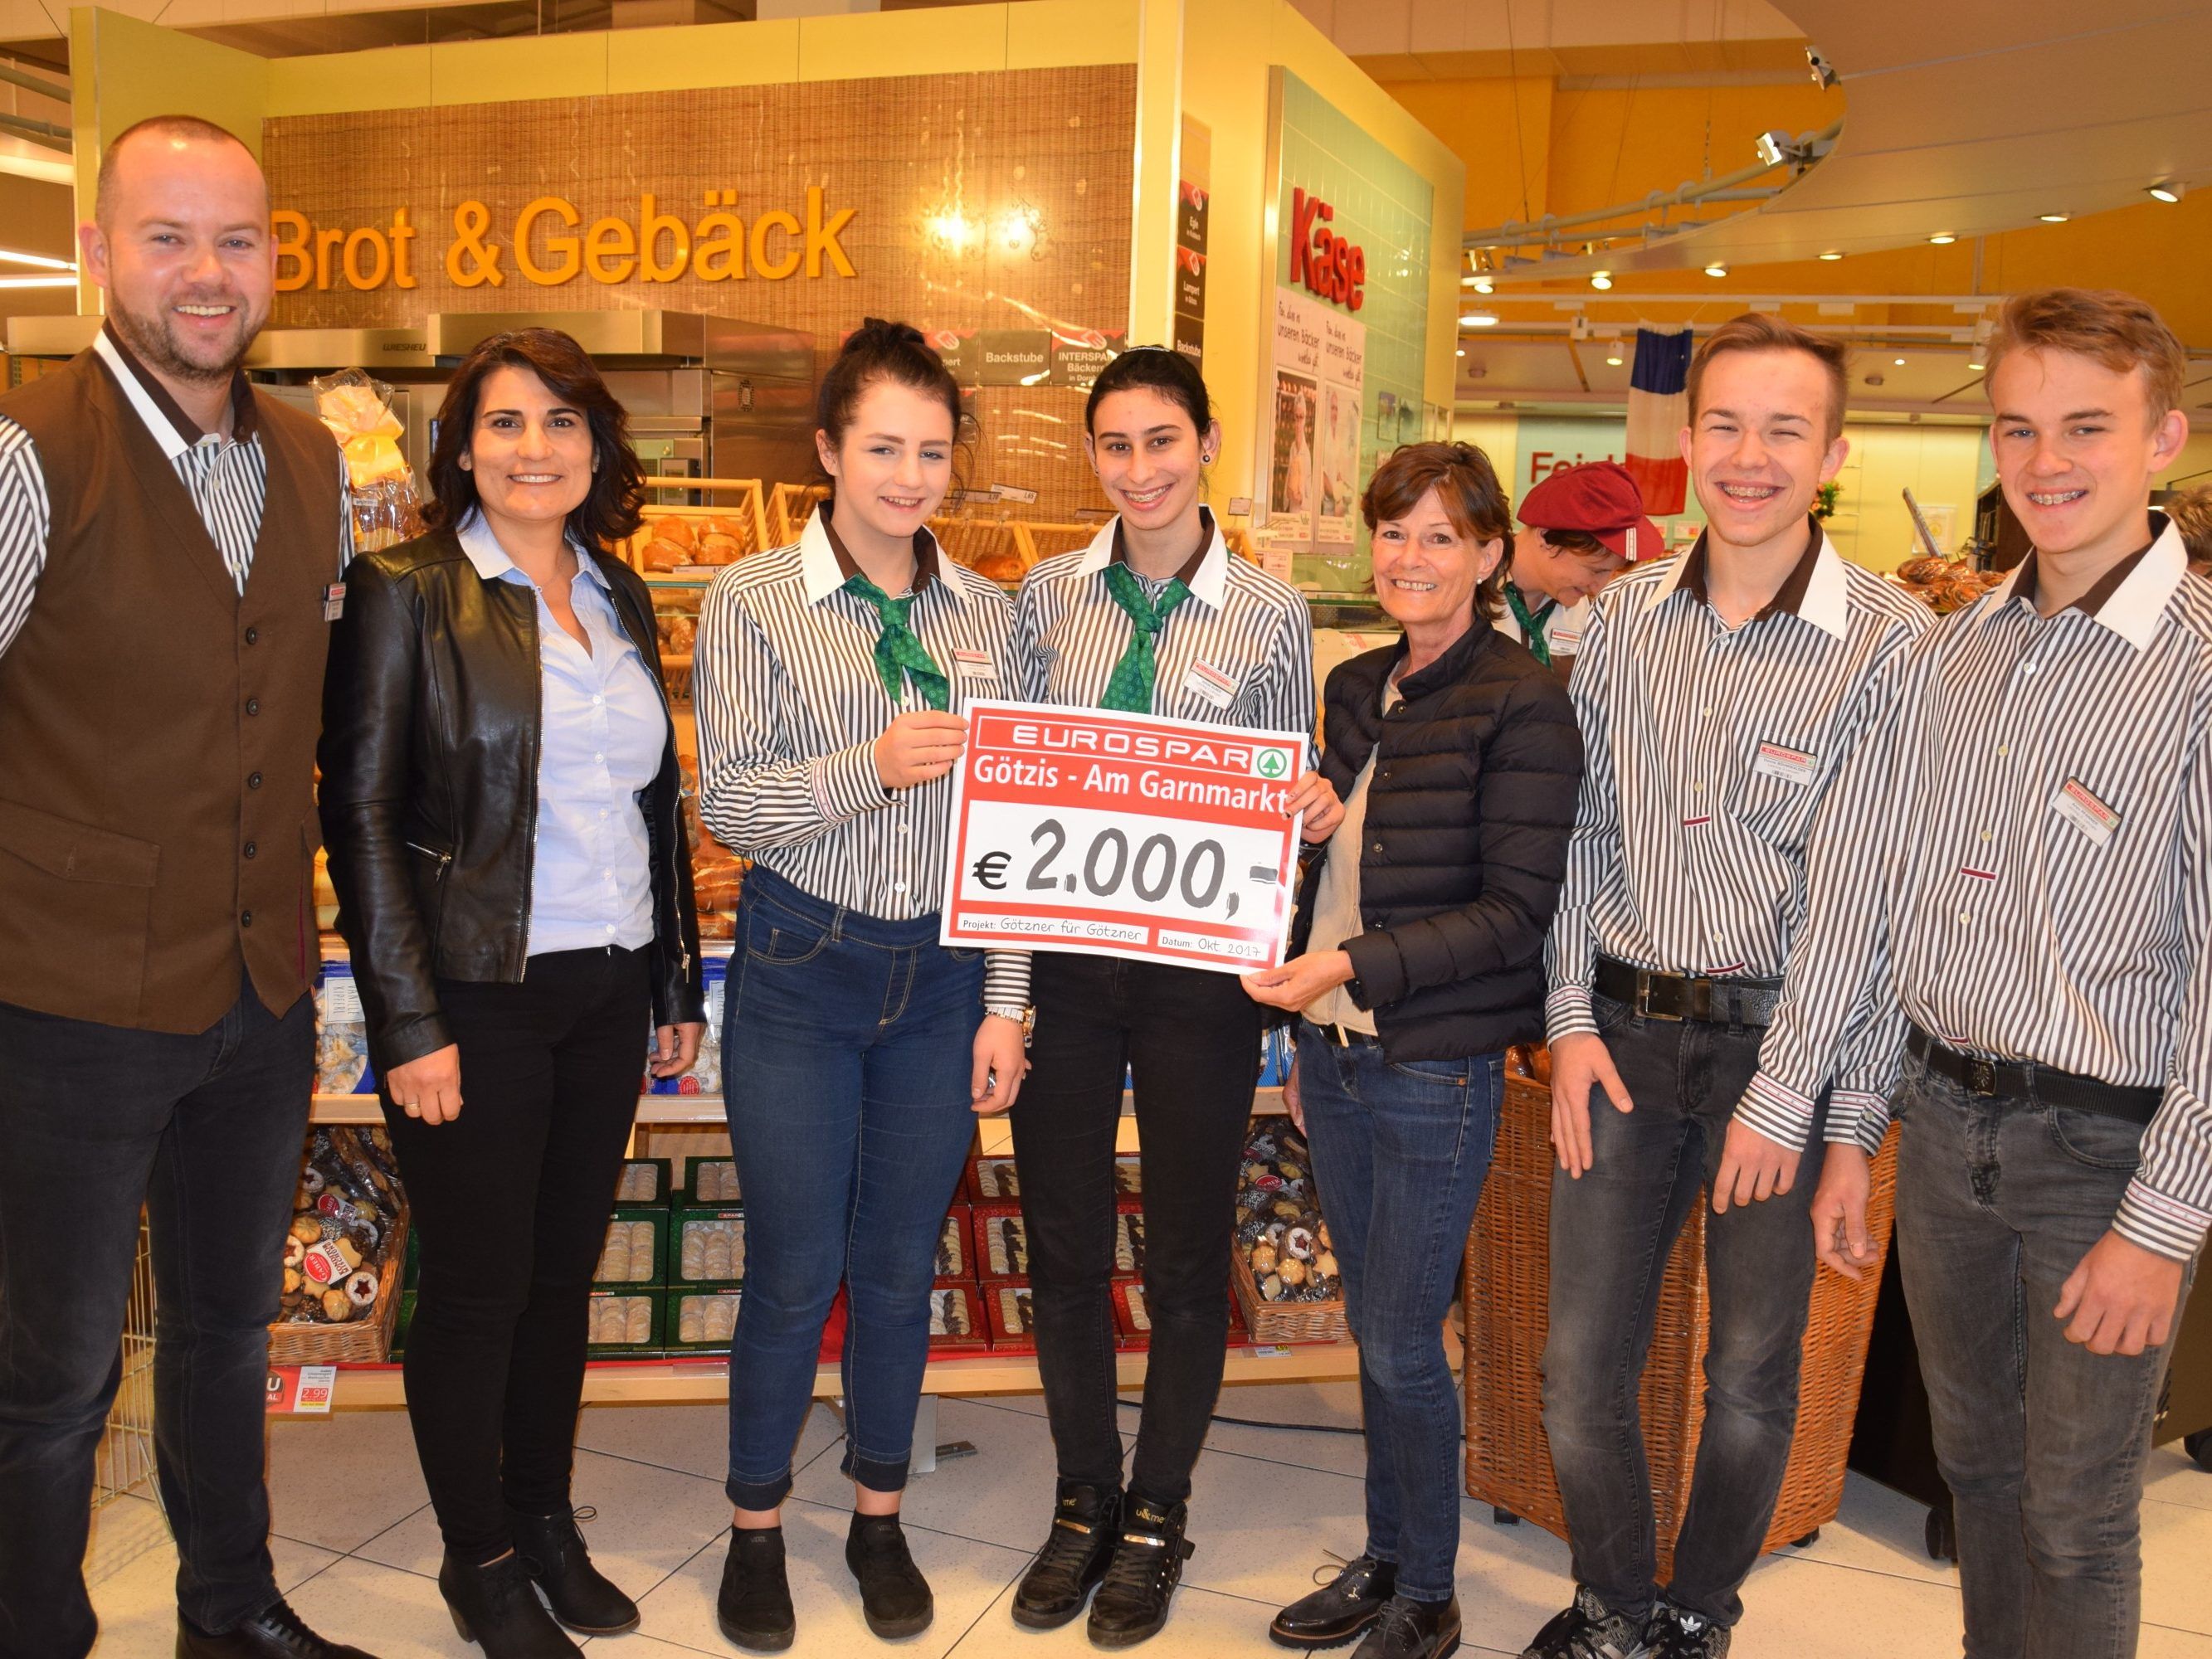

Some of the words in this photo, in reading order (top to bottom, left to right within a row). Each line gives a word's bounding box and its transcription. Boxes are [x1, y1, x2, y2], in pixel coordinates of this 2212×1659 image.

[271, 207, 416, 290] Brot
[446, 200, 504, 287] &
[514, 186, 857, 285] Gebäck
[1289, 186, 1366, 312] Käse
[985, 352, 1044, 363] Backstube
[1177, 339, 1201, 358] Backstube
[1012, 725, 1250, 770] EUROSPAR
[974, 755, 1059, 788] Götzis
[1083, 764, 1130, 795] Am
[1139, 770, 1289, 813] Garnmarkt
[972, 851, 1012, 890] €
[962, 919, 996, 930] Projekt:
[1001, 918, 1055, 932] Götzner
[1061, 919, 1081, 935] für
[1086, 922, 1142, 941] Götzner
[1162, 937, 1193, 948] Datum:
[1228, 943, 1262, 957] 2017
[302, 1388, 328, 1399] 2.99
